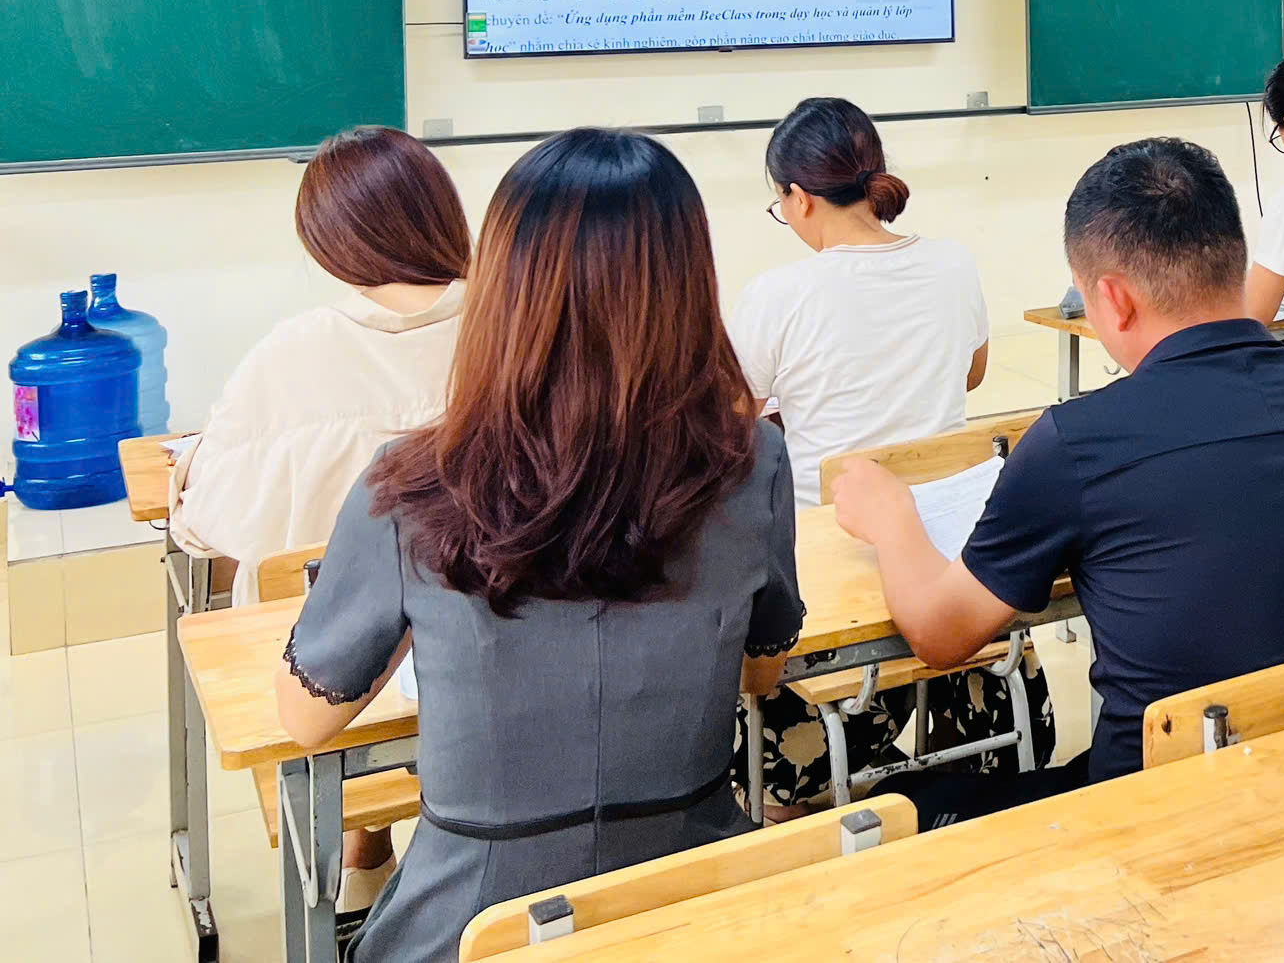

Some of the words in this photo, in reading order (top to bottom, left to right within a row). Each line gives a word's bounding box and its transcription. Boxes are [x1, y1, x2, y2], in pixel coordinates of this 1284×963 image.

[700, 9, 752, 21] BeeClass
[756, 10, 786, 21] trong
[790, 7, 810, 20] dạy
[814, 7, 834, 19] học
